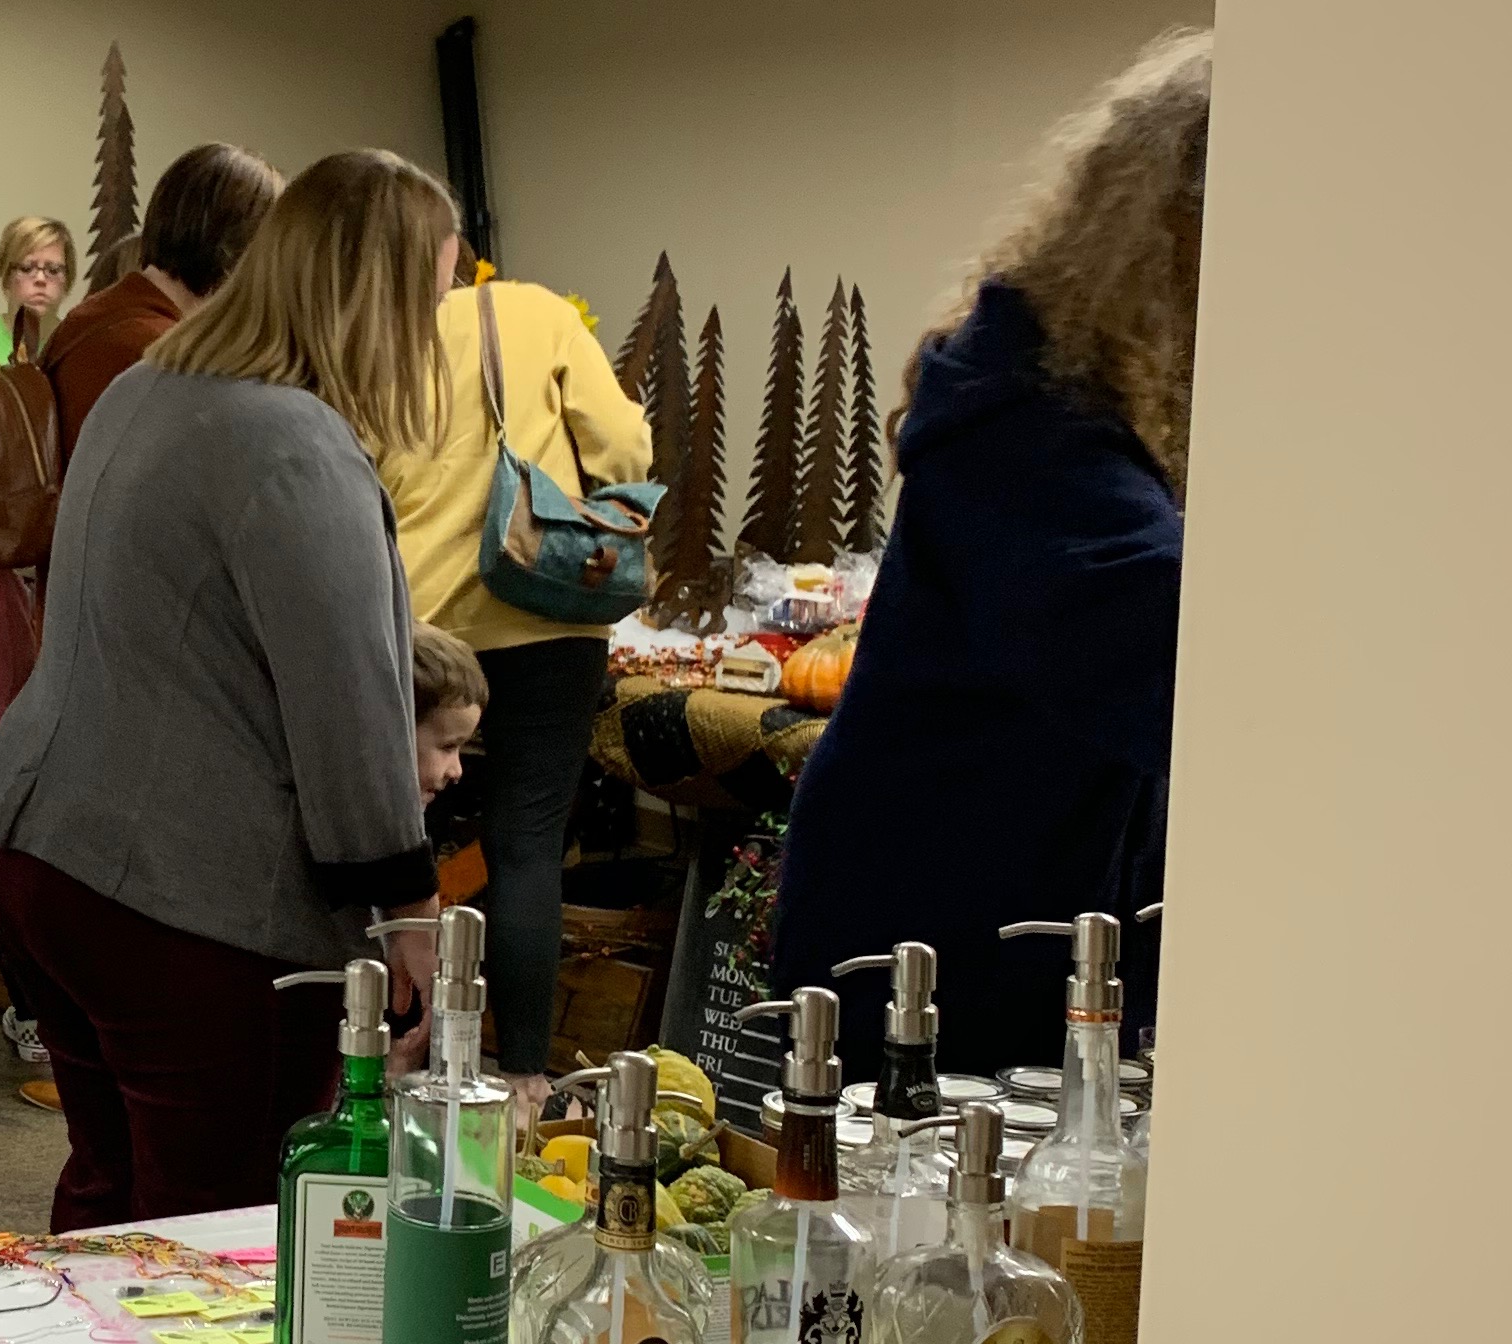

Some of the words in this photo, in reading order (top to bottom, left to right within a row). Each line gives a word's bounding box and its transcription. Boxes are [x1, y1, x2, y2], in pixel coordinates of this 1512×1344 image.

[710, 963, 753, 987] MON
[708, 985, 743, 1008] TUE
[700, 1030, 738, 1053] THU
[696, 1052, 723, 1074] FRI
